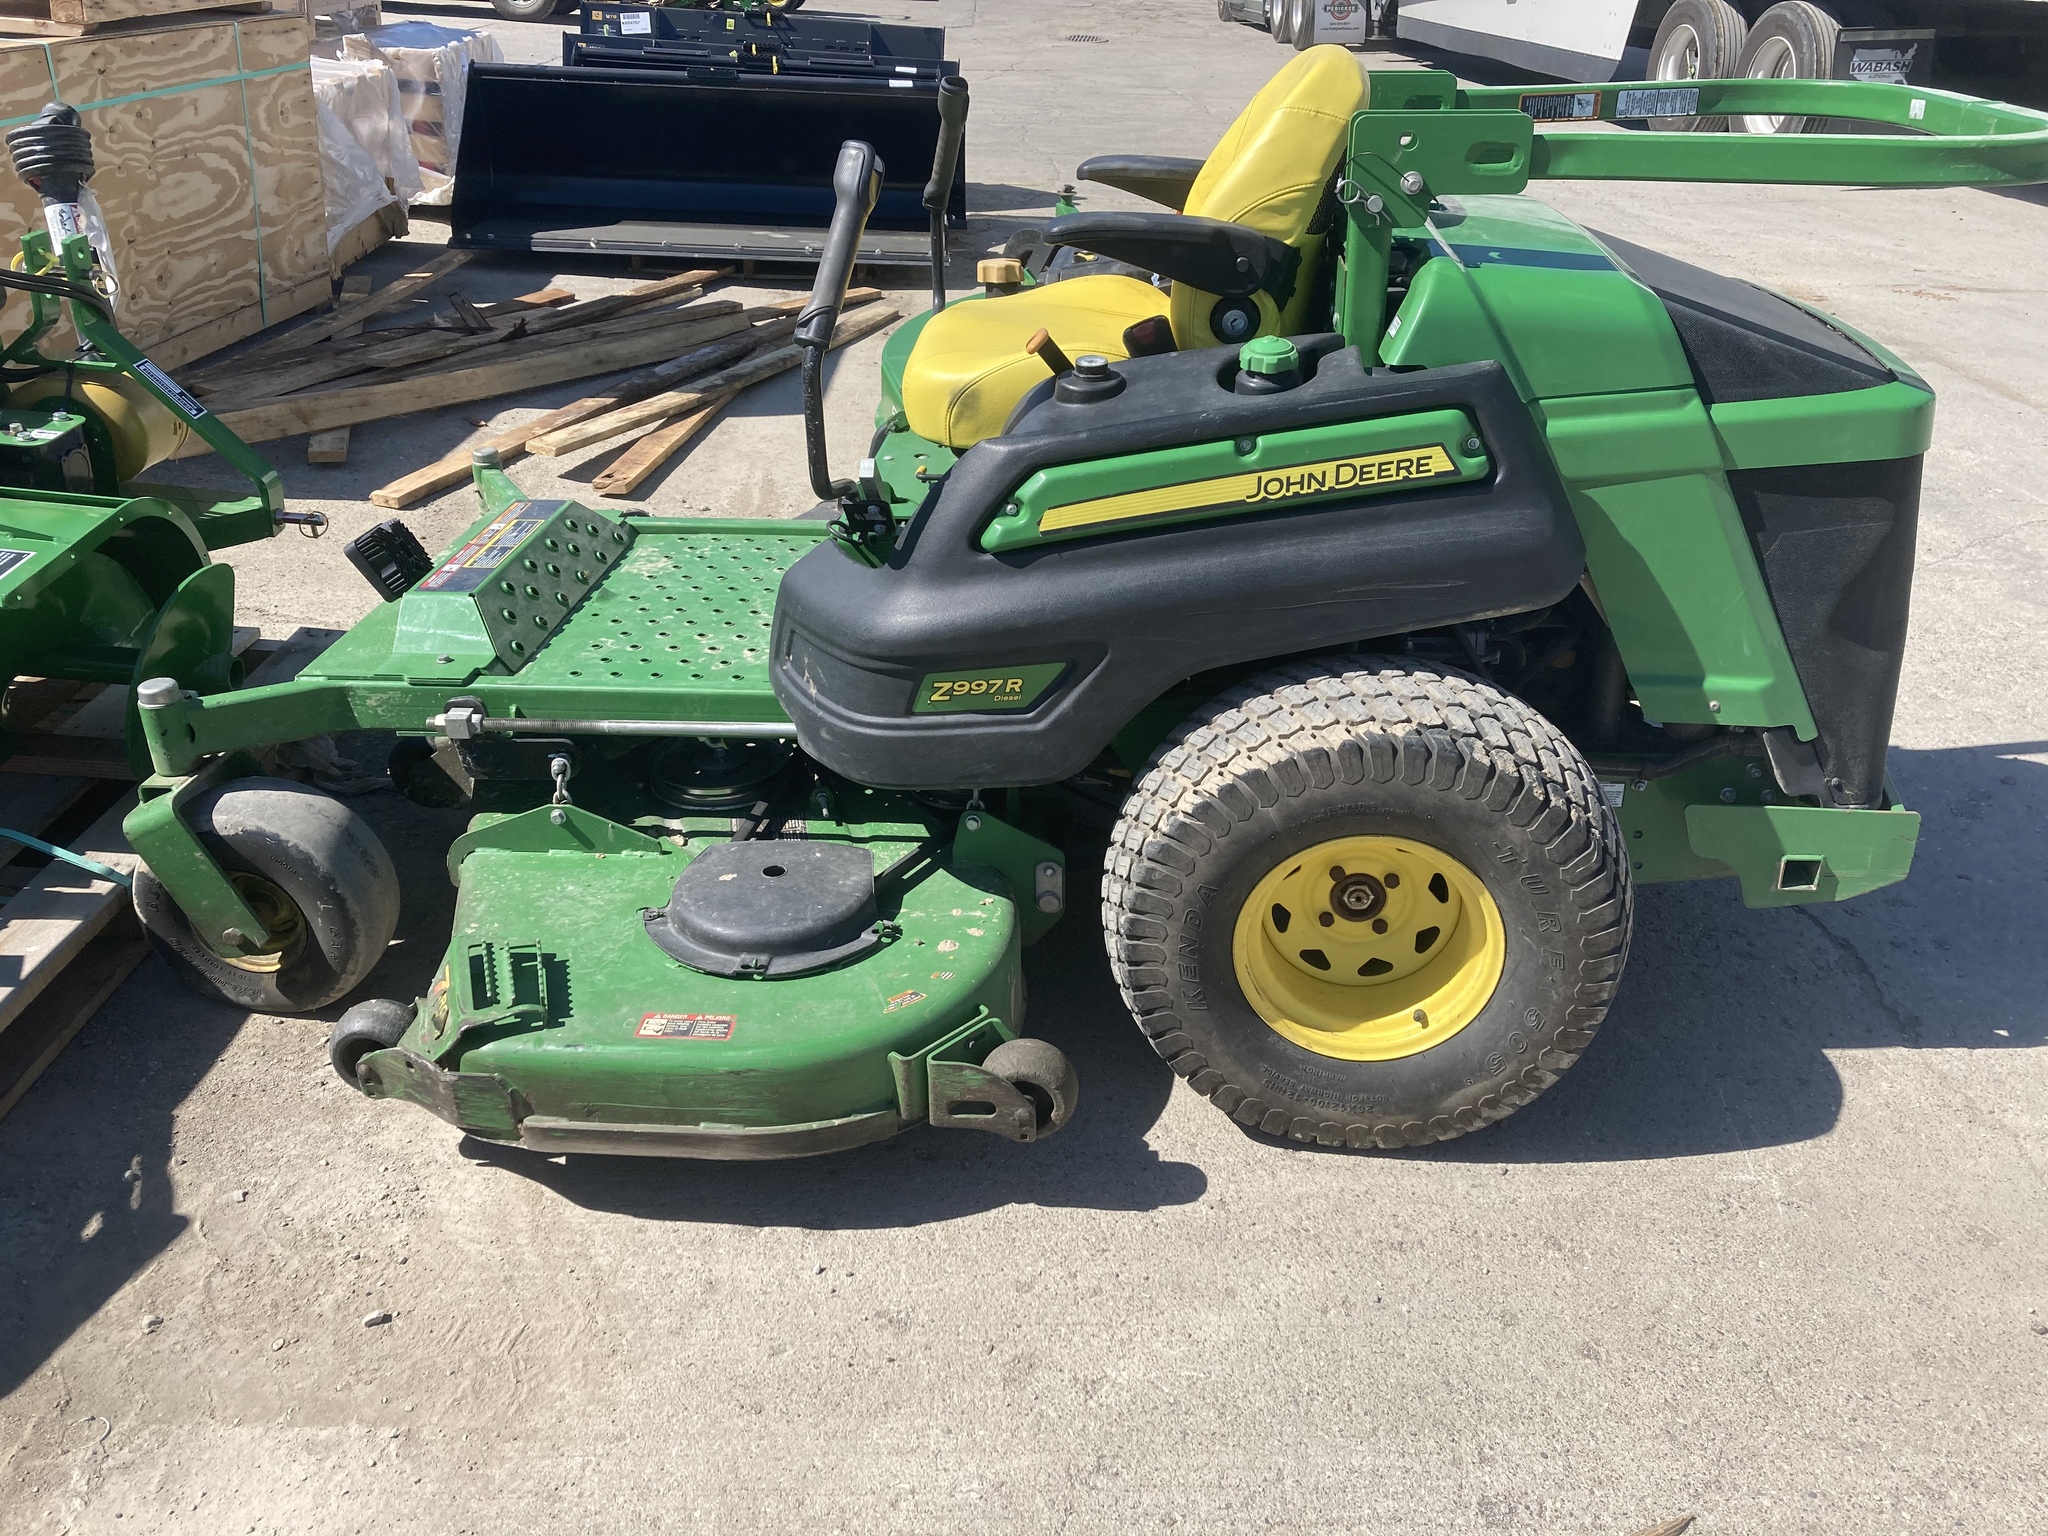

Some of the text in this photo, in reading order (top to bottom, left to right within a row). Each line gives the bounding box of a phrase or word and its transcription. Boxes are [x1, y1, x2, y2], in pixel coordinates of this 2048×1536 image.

[1850, 60, 1912, 73] WABASH
[1245, 456, 1433, 499] JOHN DEERE
[929, 678, 1024, 702] Z997R
[993, 694, 1022, 702] Diesel
[1178, 883, 1220, 1011] KENDA
[1486, 1008, 1548, 1077] 505
[1260, 1064, 1297, 1088] SERVICE
